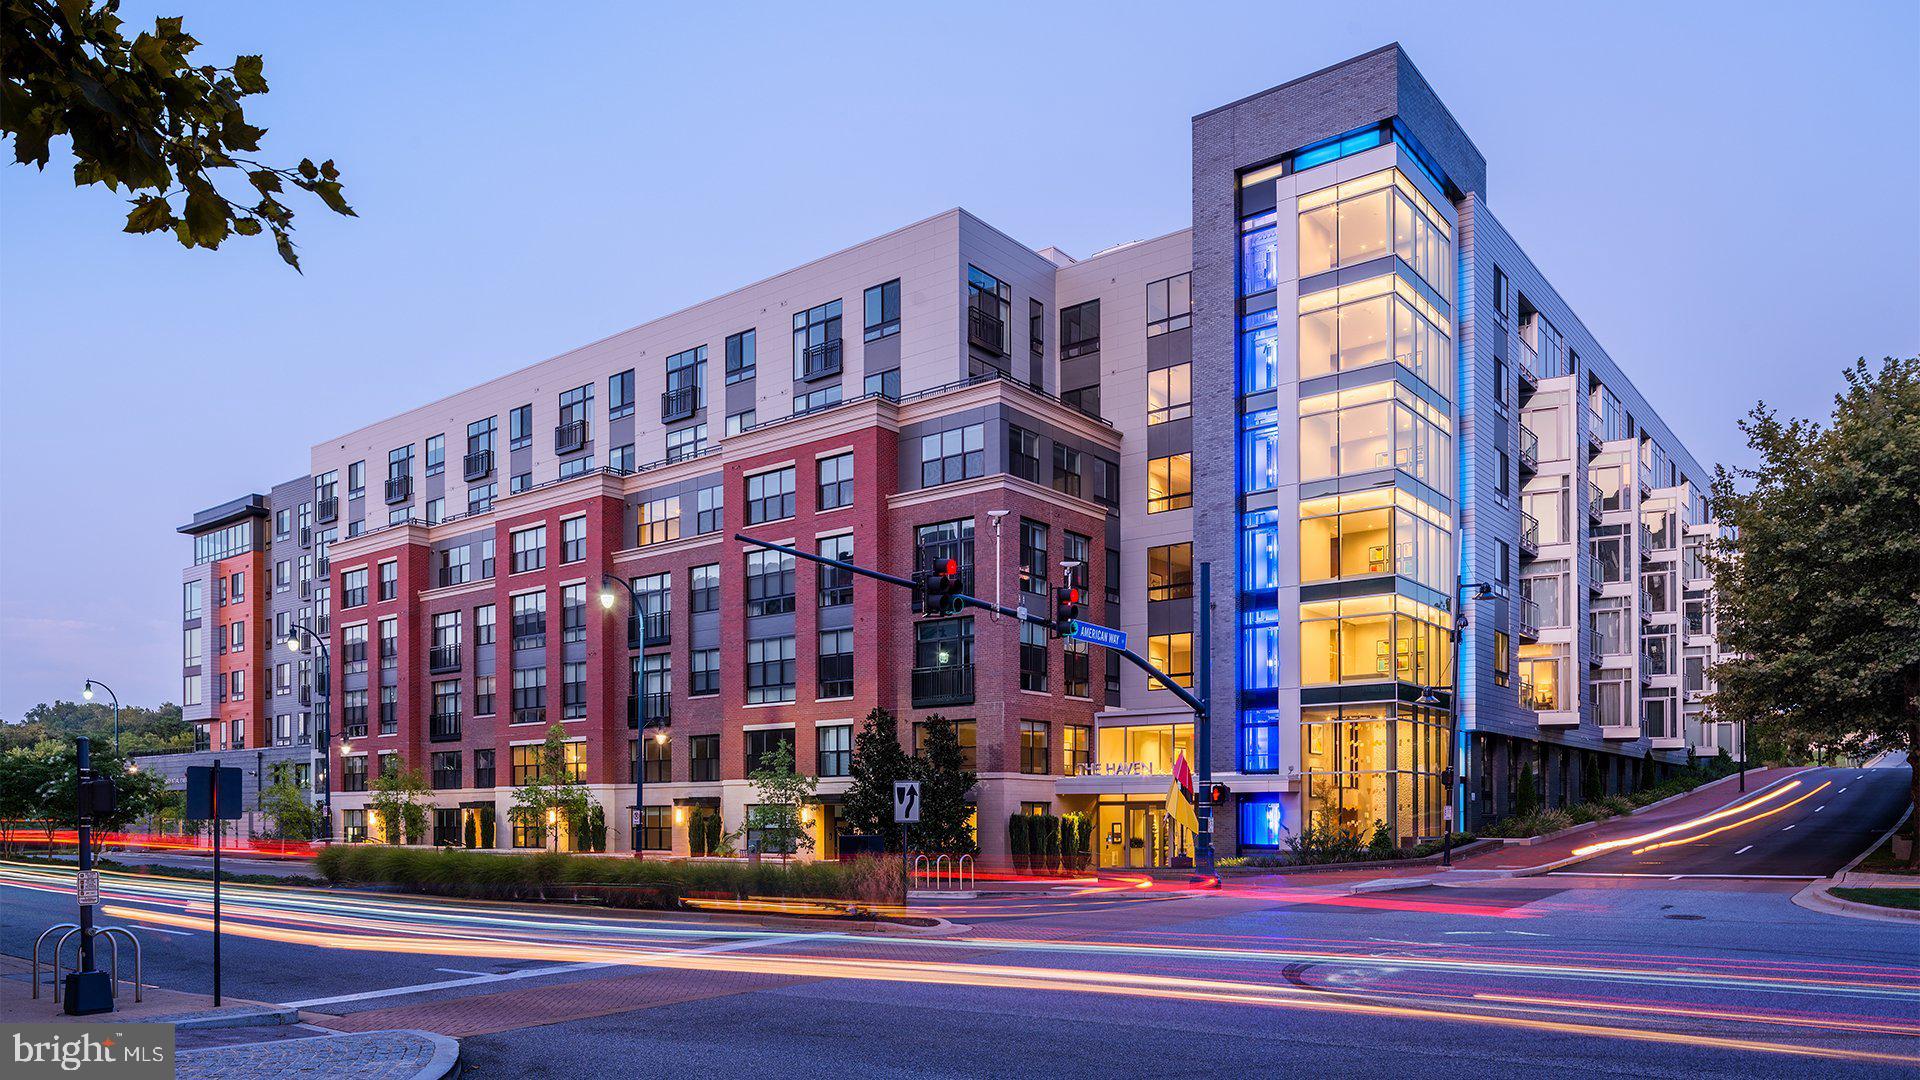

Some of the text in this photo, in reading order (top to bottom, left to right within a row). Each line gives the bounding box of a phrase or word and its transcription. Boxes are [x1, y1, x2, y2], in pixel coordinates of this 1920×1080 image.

[1080, 626, 1120, 645] AMERICAN WAY
[1077, 762, 1153, 776] THE HAVEN
